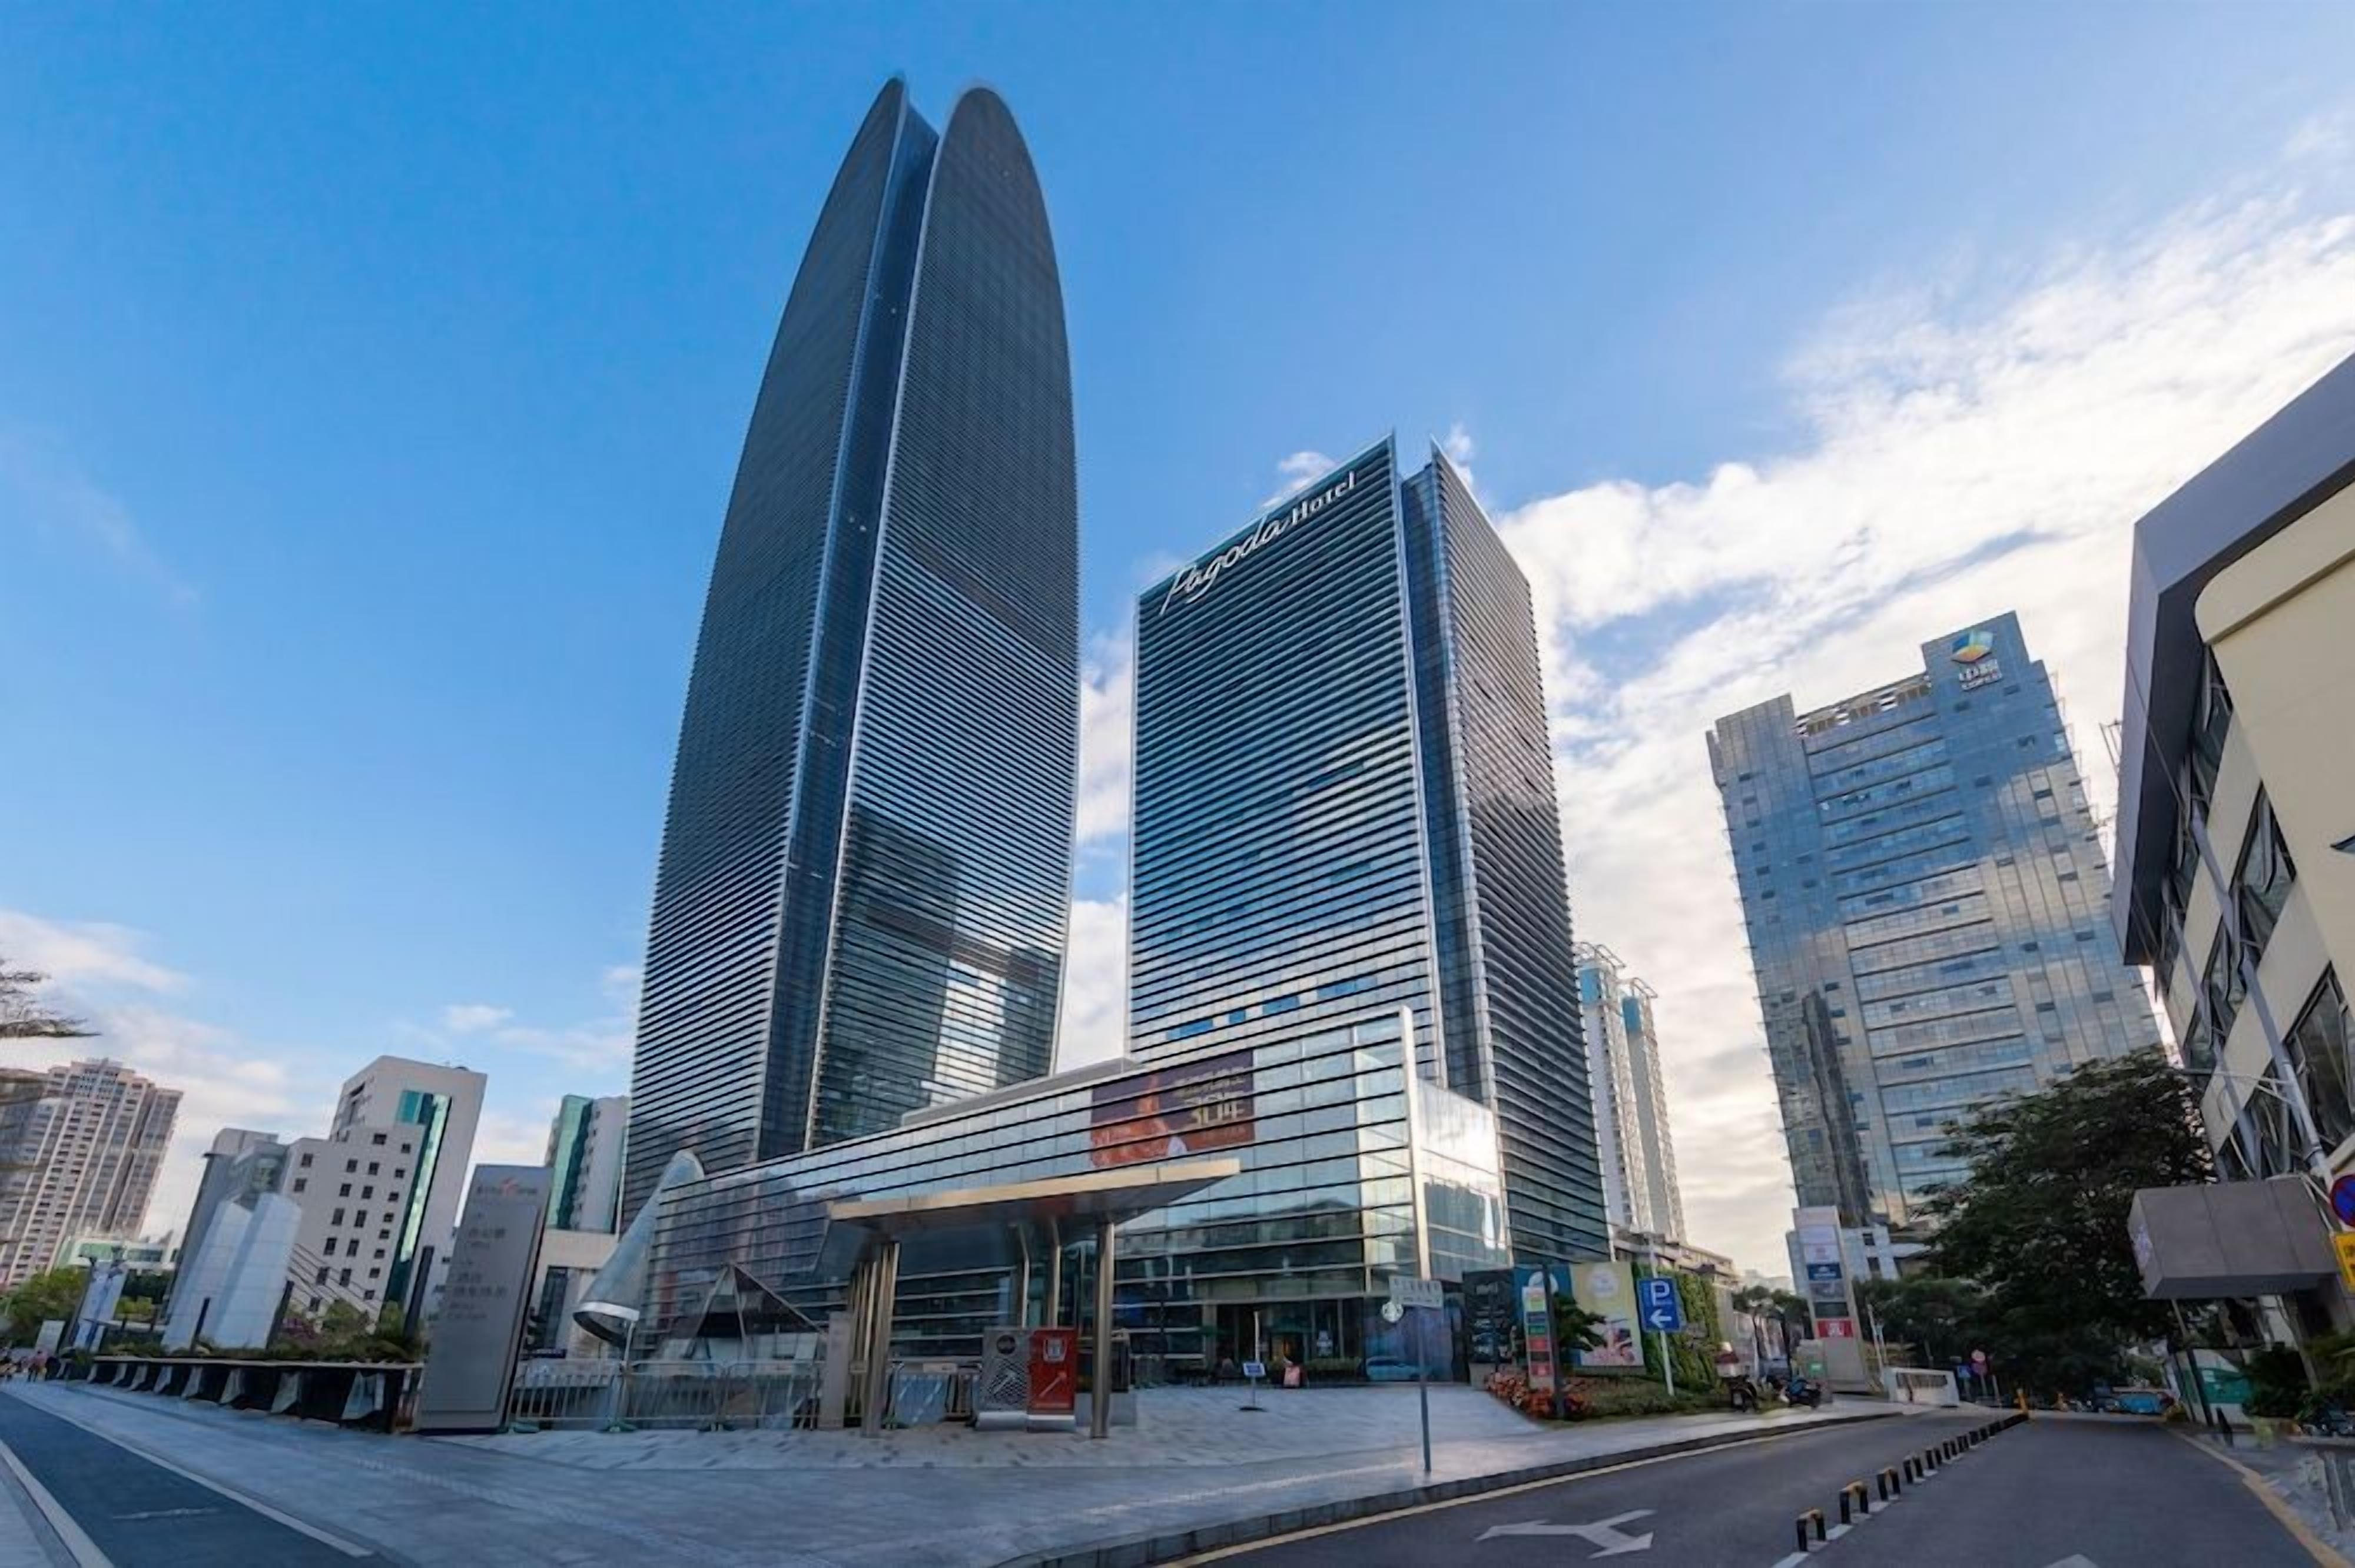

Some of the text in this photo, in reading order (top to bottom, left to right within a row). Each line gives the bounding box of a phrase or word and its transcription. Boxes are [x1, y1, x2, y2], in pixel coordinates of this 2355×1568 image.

[1159, 470, 1355, 616] Pagoda Hotel
[1651, 1280, 1670, 1306] P
